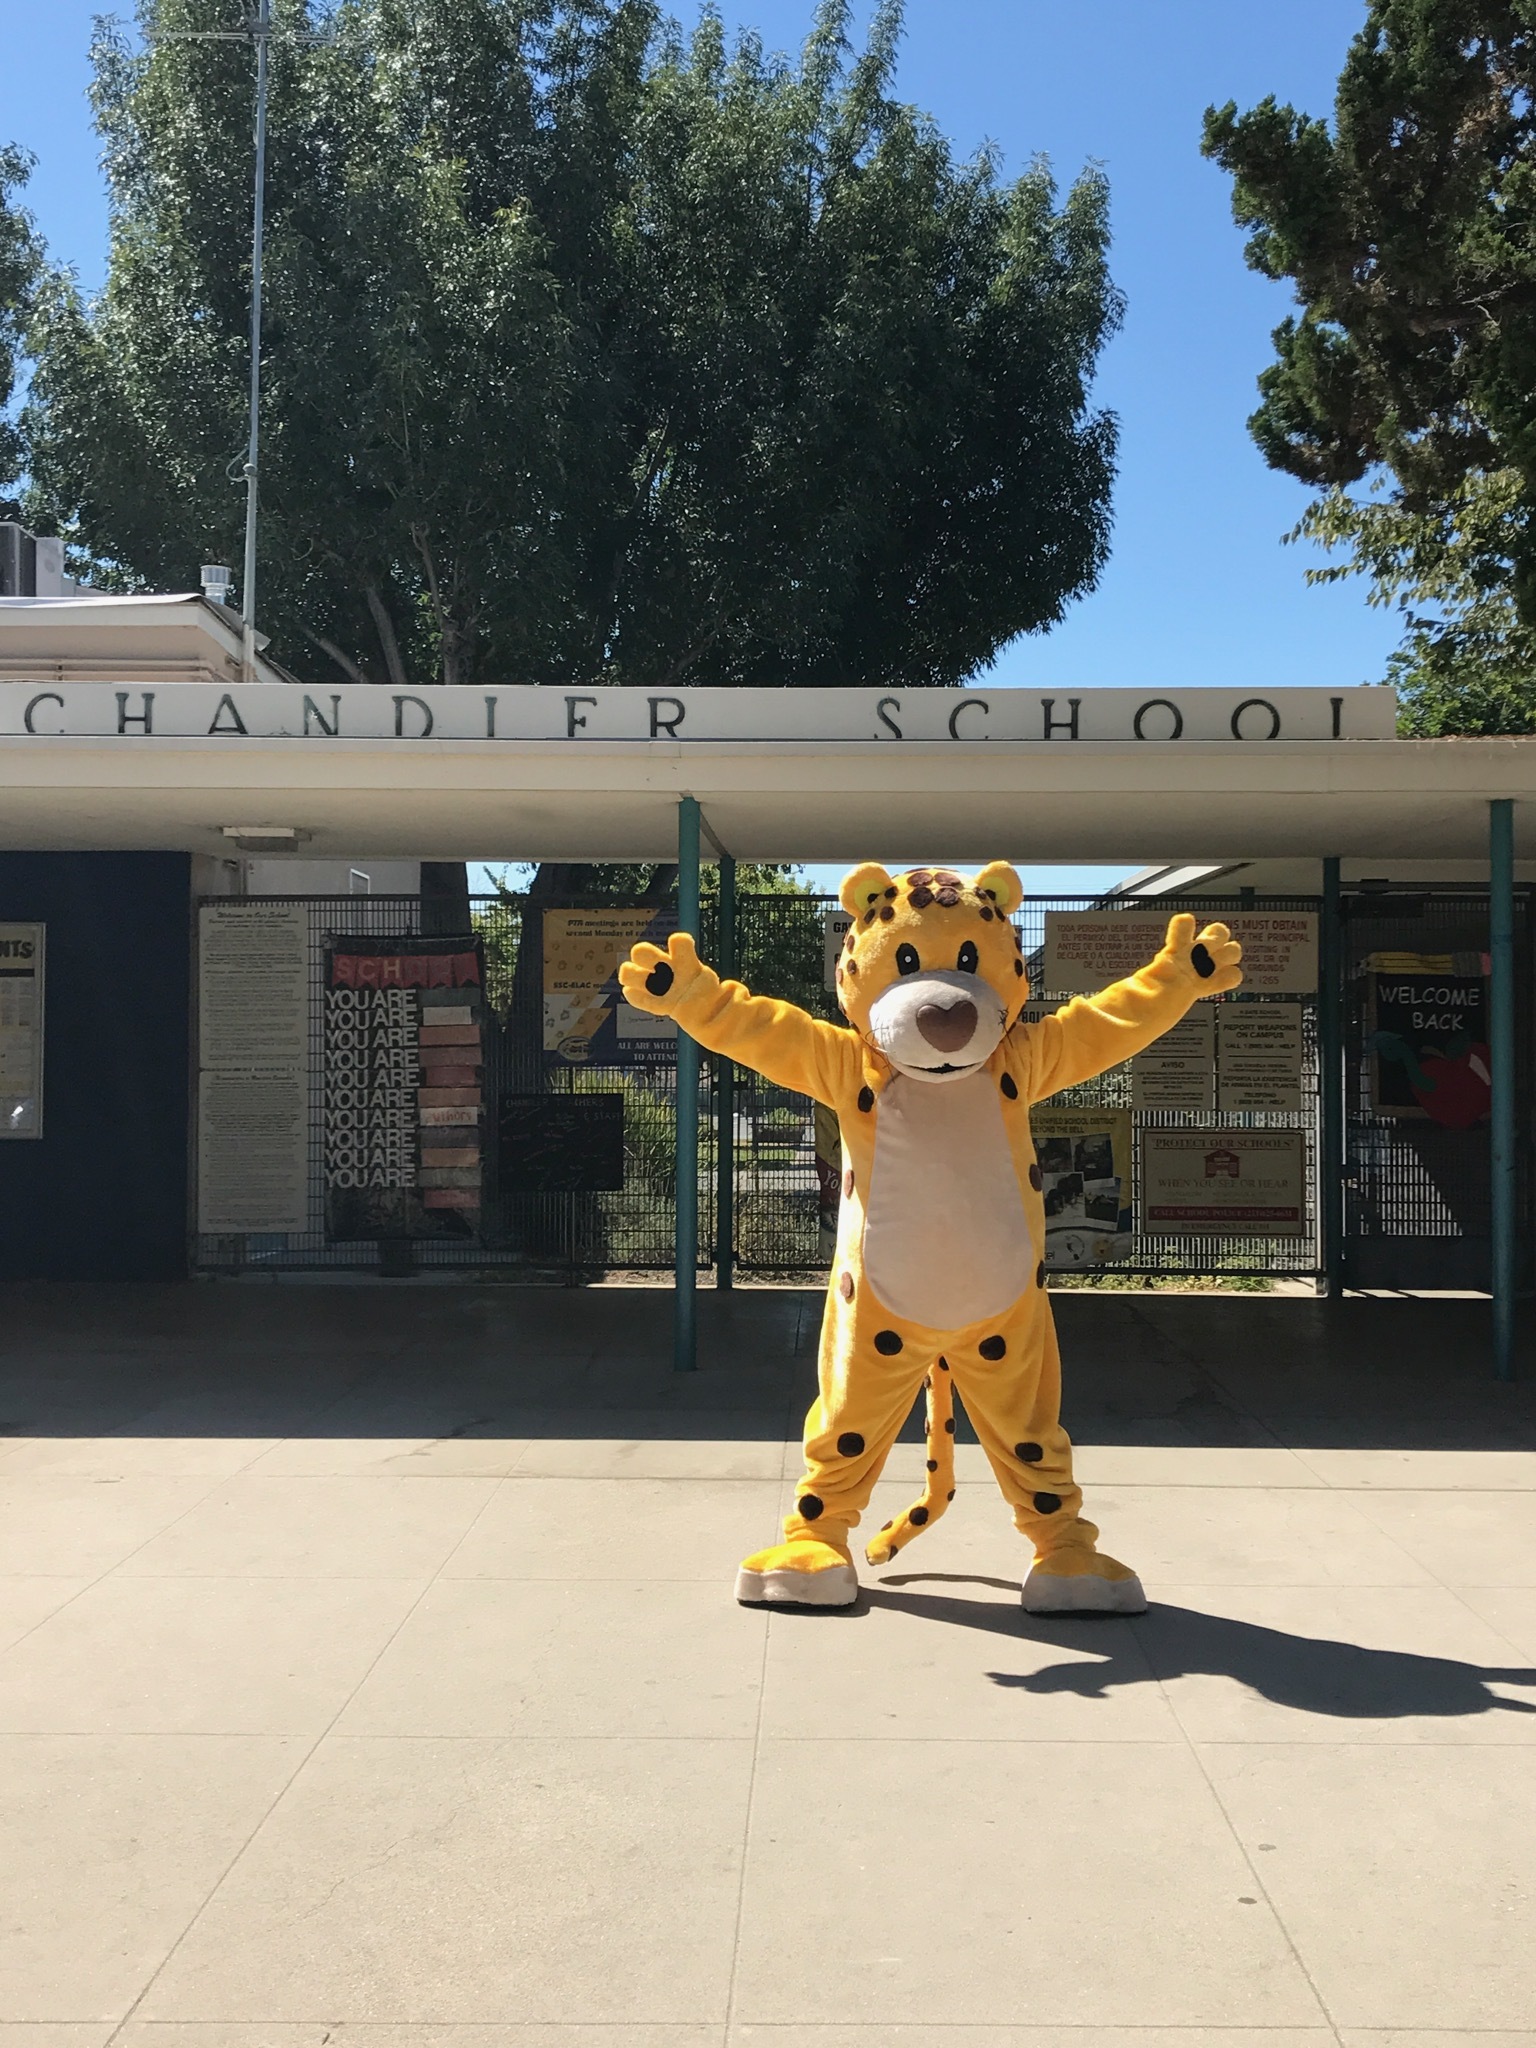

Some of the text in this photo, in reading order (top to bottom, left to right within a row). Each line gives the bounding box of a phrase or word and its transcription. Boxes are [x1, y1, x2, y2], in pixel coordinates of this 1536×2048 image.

[1242, 920, 1269, 930] MUST
[1272, 920, 1307, 930] OBTAIN
[1248, 933, 1264, 941] THE
[1267, 933, 1310, 942] PRINCIPAL
[326, 989, 417, 1009] YOU ARE
[1379, 984, 1480, 1006] WELCOME
[326, 1008, 418, 1029] YOU ARE
[1412, 1011, 1464, 1031] BACK
[326, 1027, 418, 1049] YOU ARE
[326, 1049, 370, 1068] YOU
[373, 1049, 419, 1068] ARE
[326, 1069, 420, 1088] YOU ARE
[326, 1089, 415, 1108] YOU ARE
[325, 1109, 367, 1129] YOU
[369, 1108, 415, 1128] ARE
[325, 1129, 415, 1148] YOU ARE
[1209, 1139, 1234, 1148] OUR
[325, 1148, 415, 1168] YOU ARE
[324, 1168, 415, 1188] YOU ARE
[1158, 1179, 1190, 1188] WHEN
[1193, 1179, 1214, 1188] YOU
[1218, 1179, 1238, 1188] SEE
[1258, 1179, 1289, 1188] HEAR
